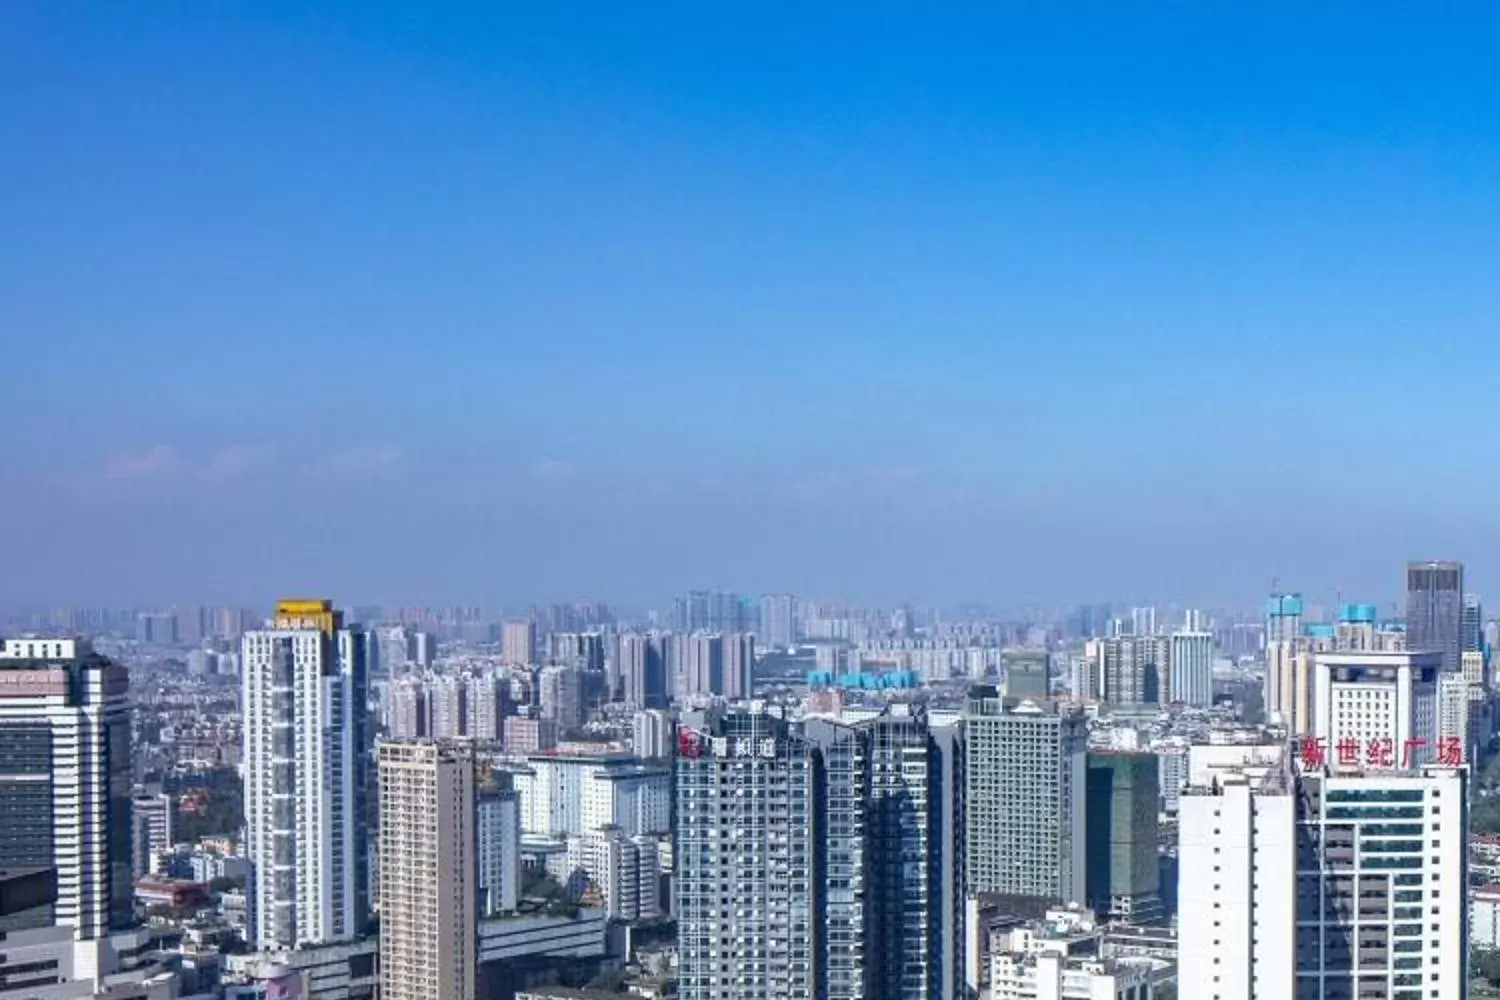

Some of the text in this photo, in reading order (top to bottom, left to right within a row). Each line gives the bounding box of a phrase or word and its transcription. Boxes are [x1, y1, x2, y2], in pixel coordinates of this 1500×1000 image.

[1302, 736, 1461, 768] 新世纪广场
